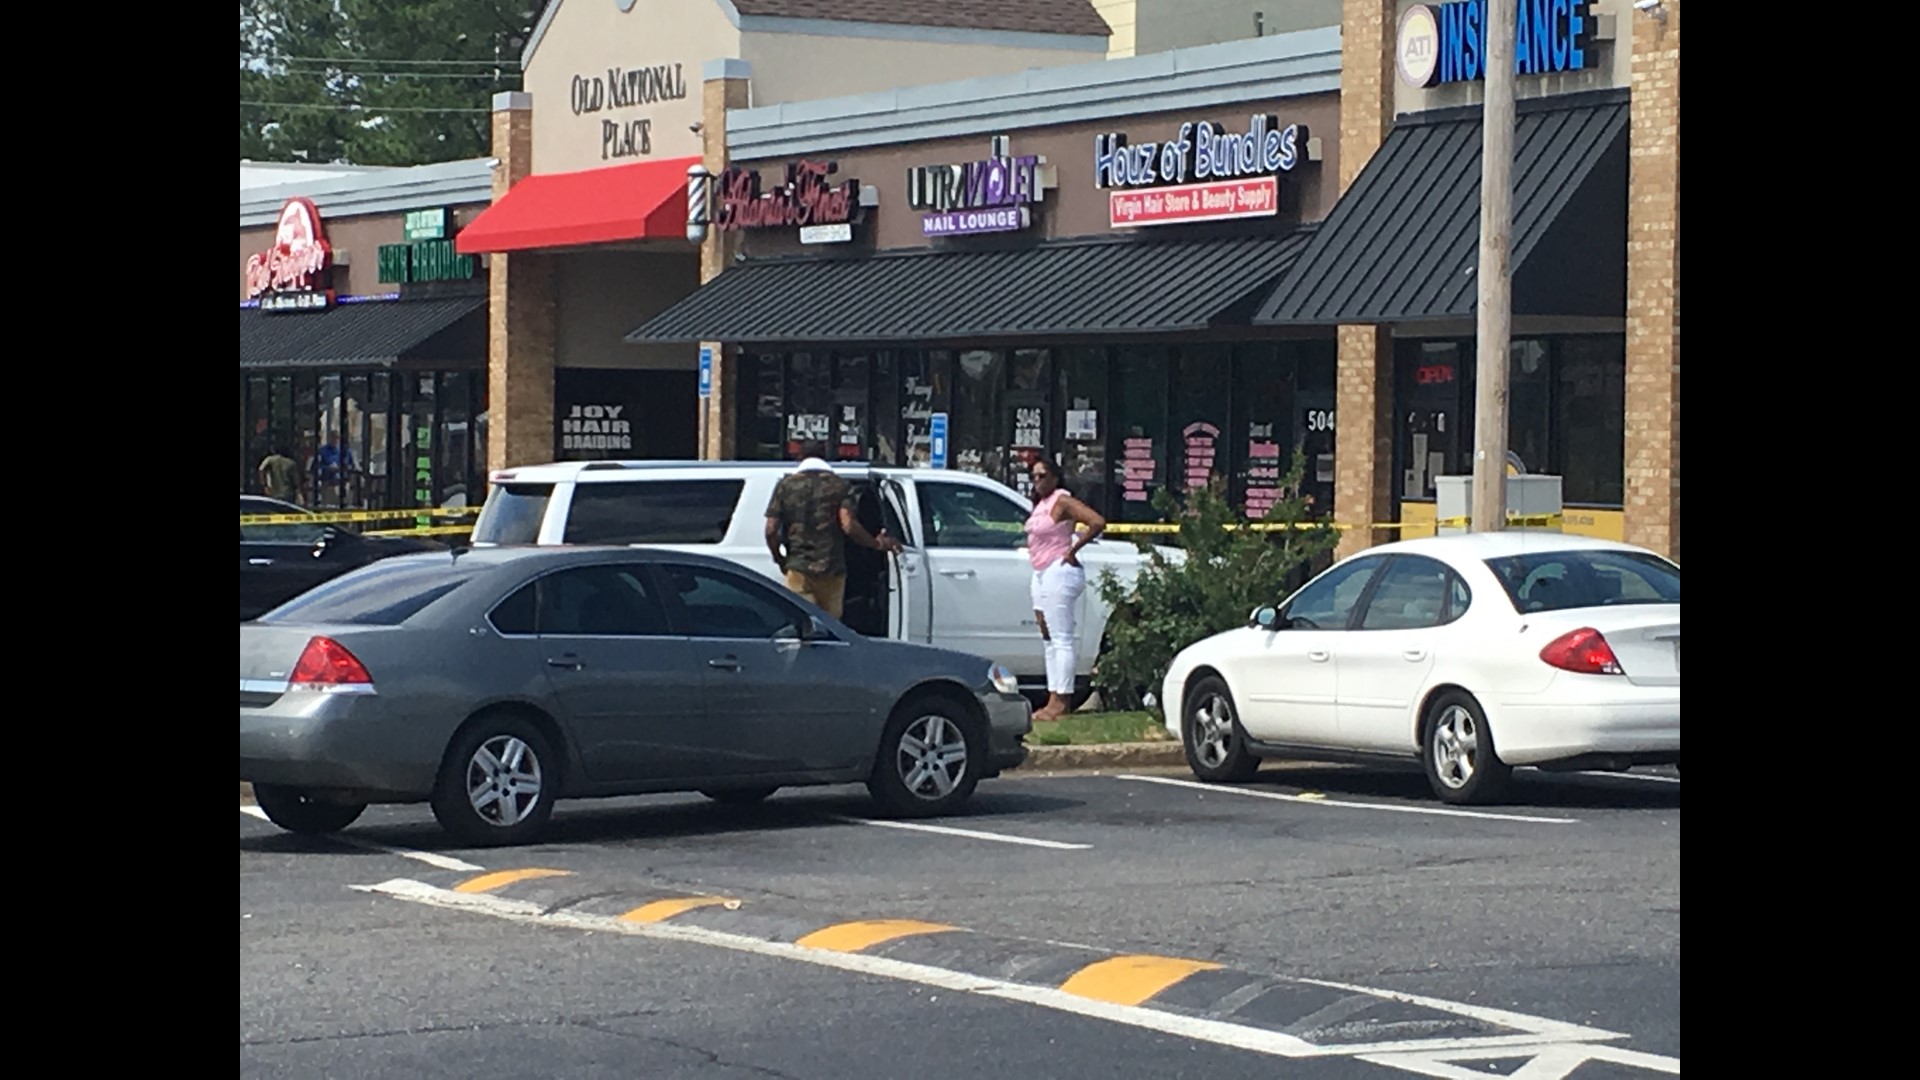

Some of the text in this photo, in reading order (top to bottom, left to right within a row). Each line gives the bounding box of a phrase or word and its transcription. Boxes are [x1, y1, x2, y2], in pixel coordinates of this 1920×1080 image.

[1404, 0, 1584, 83] ATI INSANCE
[571, 63, 686, 116] OLD NATIONAL
[601, 118, 651, 160] PLACE
[1095, 114, 1298, 189] Houz of Bundles
[1114, 184, 1272, 220] Virgin Hair Store & Beauty Supply
[924, 210, 1017, 233] NAIL LOUNGE
[563, 420, 630, 433] HAIR
[569, 405, 623, 418] JOY
[563, 435, 632, 449] BRAIDING
